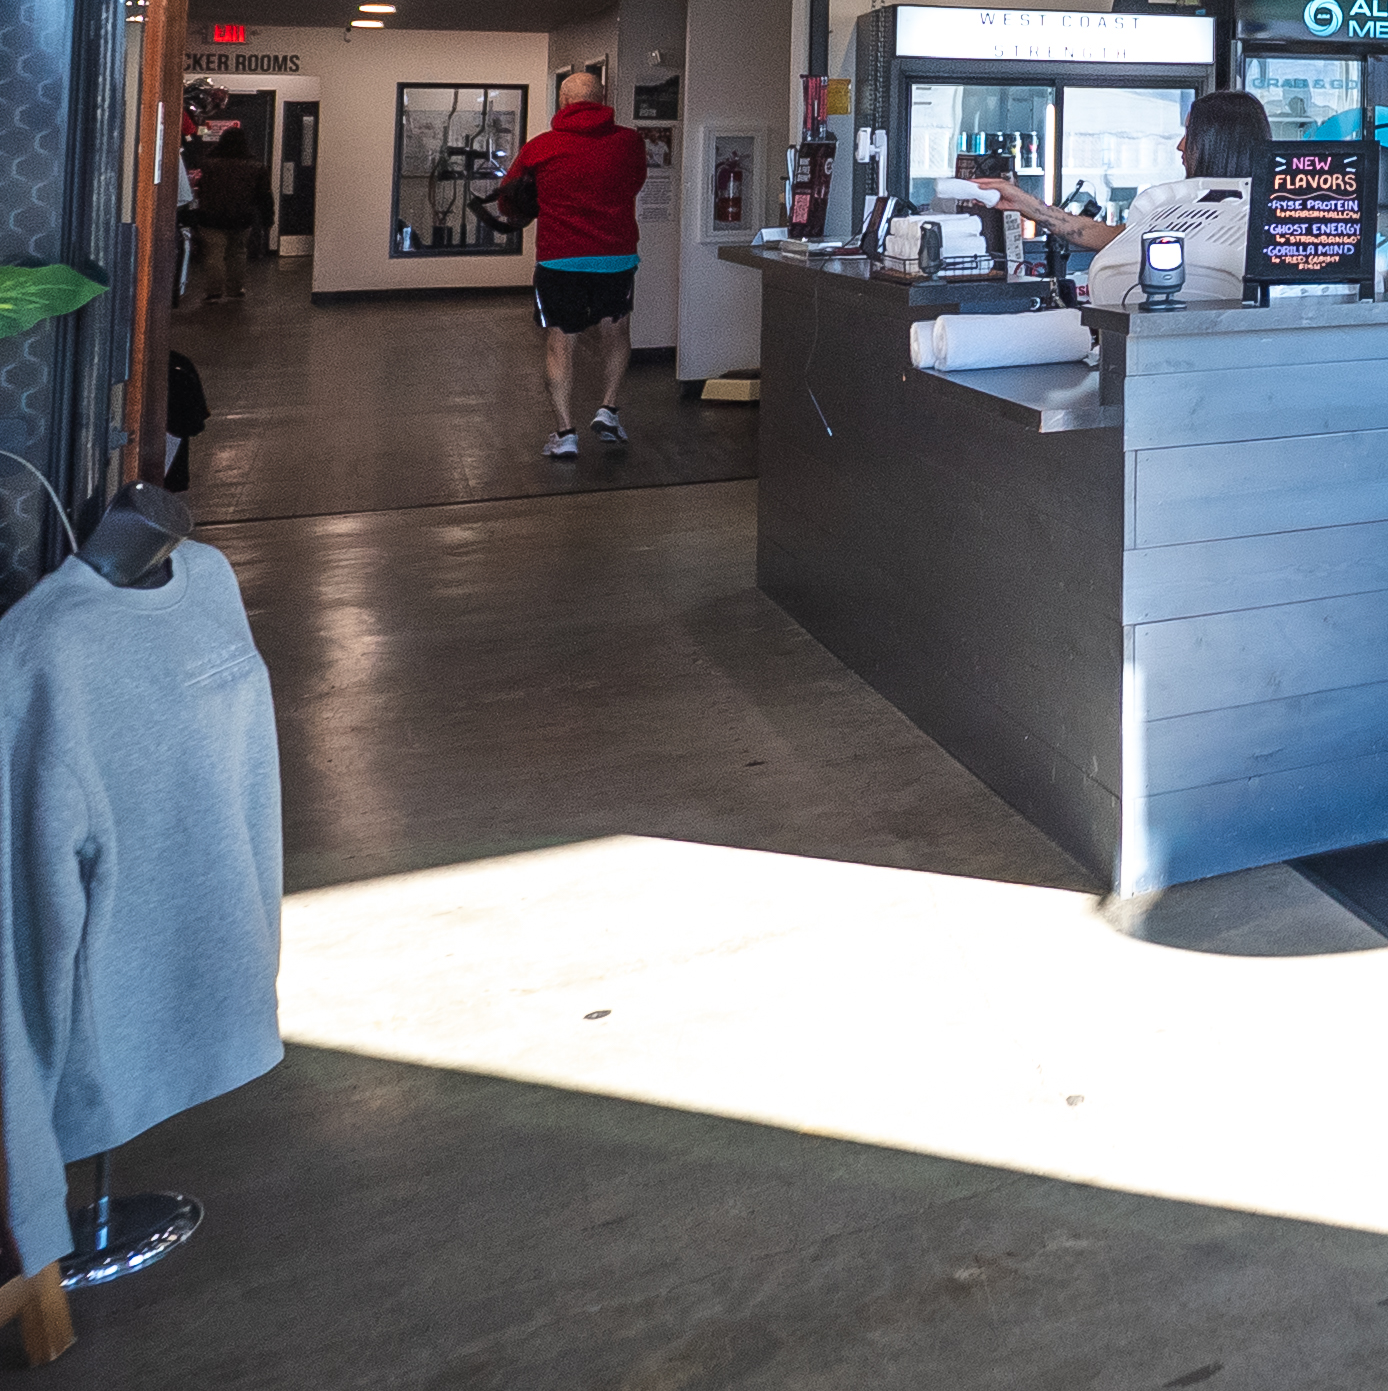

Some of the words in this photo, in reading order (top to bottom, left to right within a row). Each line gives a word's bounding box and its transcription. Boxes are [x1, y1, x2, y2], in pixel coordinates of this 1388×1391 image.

[980, 12, 1047, 26] WEST
[1062, 15, 1140, 29] COAST
[994, 45, 1127, 59] STRENGTH
[184, 53, 229, 72] CKER
[235, 53, 300, 73] ROOMS
[1292, 156, 1331, 170] NEW
[1274, 174, 1357, 191] FLAVORS
[1272, 200, 1302, 210] RYSE
[1307, 200, 1359, 210] PROTEIN
[1286, 210, 1360, 219] MARSHMALLOW
[1269, 223, 1308, 234] GHOST
[1312, 223, 1360, 234] ENERGY
[1267, 245, 1315, 256] GORILLA
[1318, 245, 1355, 255] MIND
